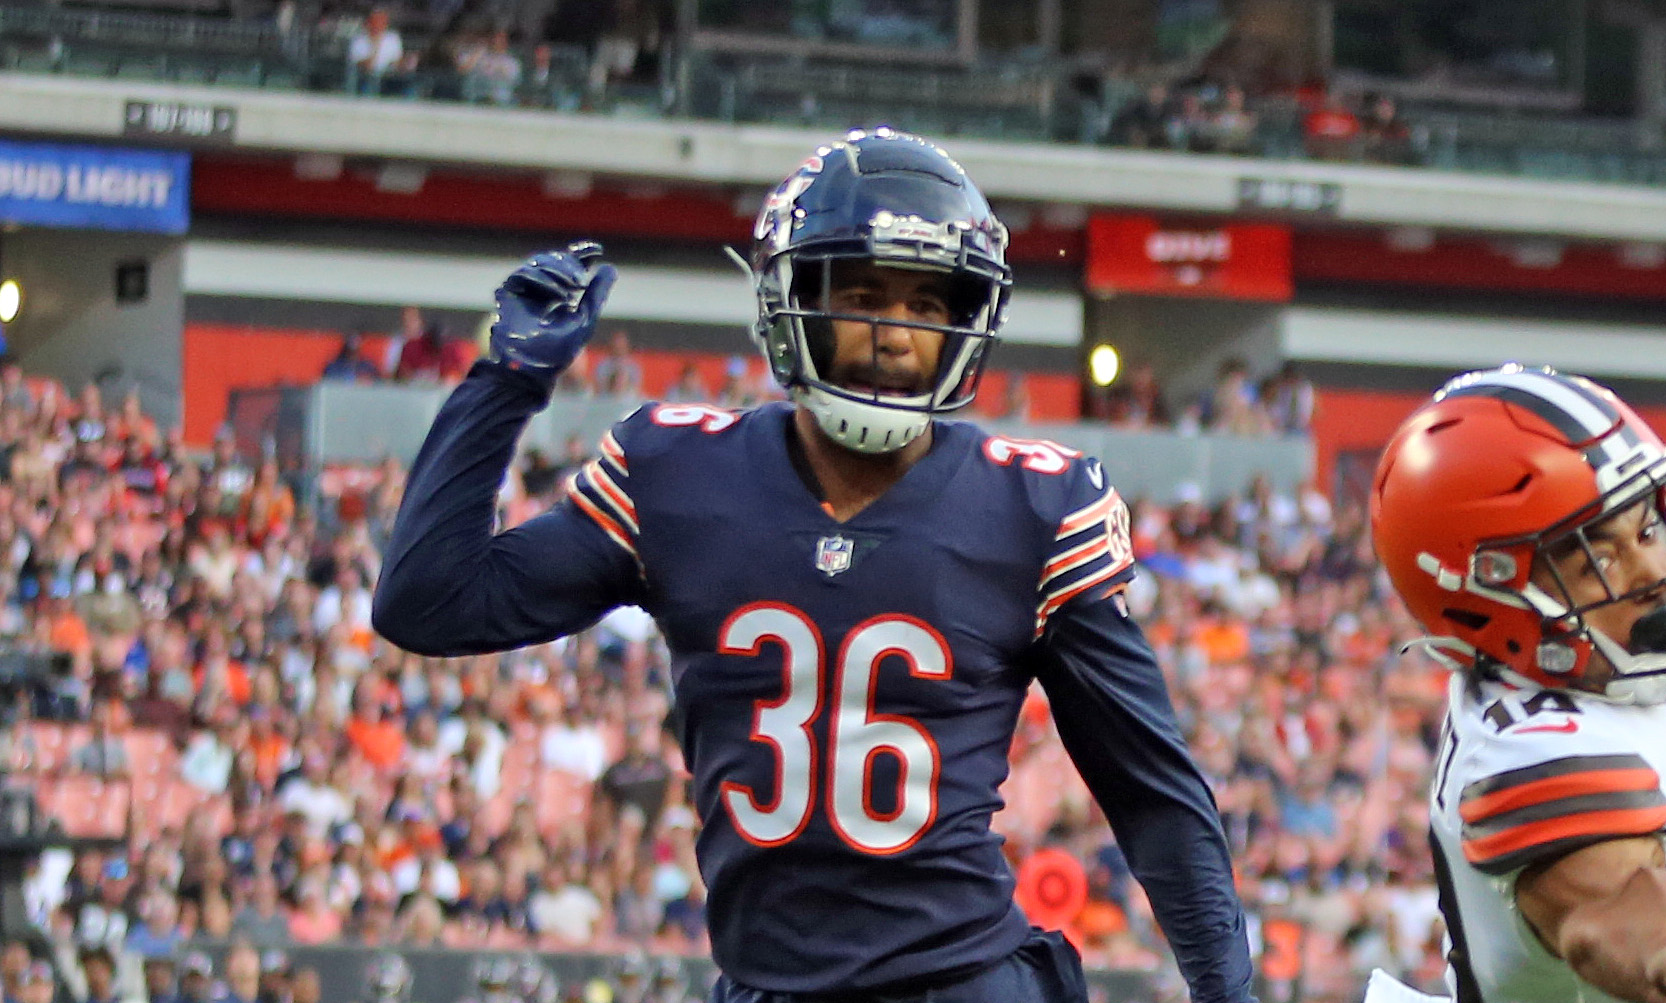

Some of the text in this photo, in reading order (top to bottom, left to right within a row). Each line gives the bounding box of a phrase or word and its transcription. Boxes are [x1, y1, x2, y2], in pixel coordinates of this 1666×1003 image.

[66, 164, 171, 210] LIGHT
[983, 436, 1083, 475] 3
[718, 600, 954, 855] 36
